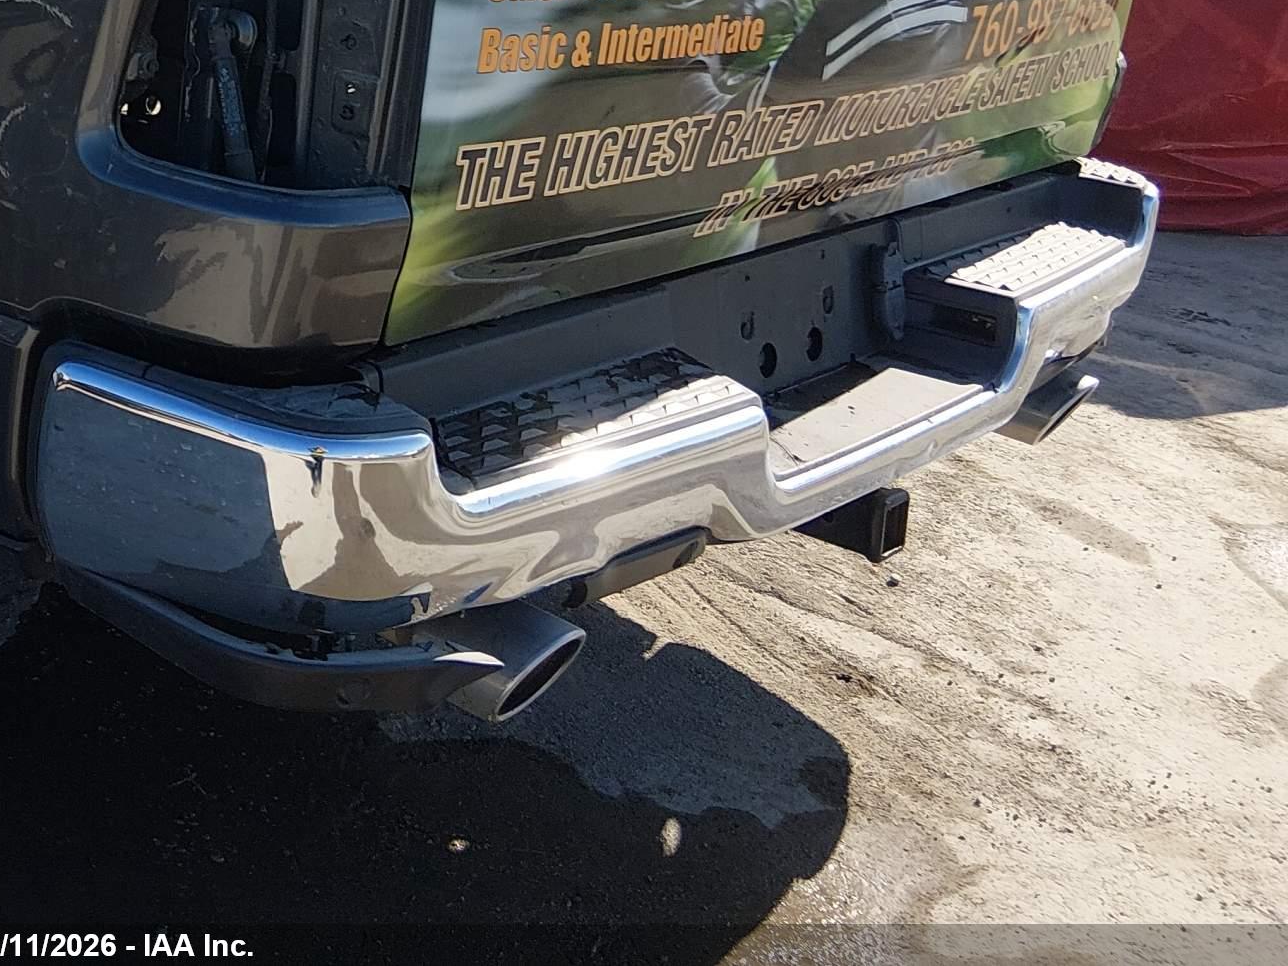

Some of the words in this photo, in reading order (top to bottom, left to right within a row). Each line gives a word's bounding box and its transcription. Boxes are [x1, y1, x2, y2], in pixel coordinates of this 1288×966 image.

[477, 25, 568, 74] Basic
[571, 30, 592, 68] &
[597, 14, 765, 66] Intermediate
[455, 137, 546, 210] THE
[543, 113, 716, 197] HIGHEST
[707, 99, 825, 168] RATED
[815, 69, 987, 146] MOTORCYCLE
[978, 51, 1061, 111] SAFETY
[1051, 41, 1115, 91] SCHOOL
